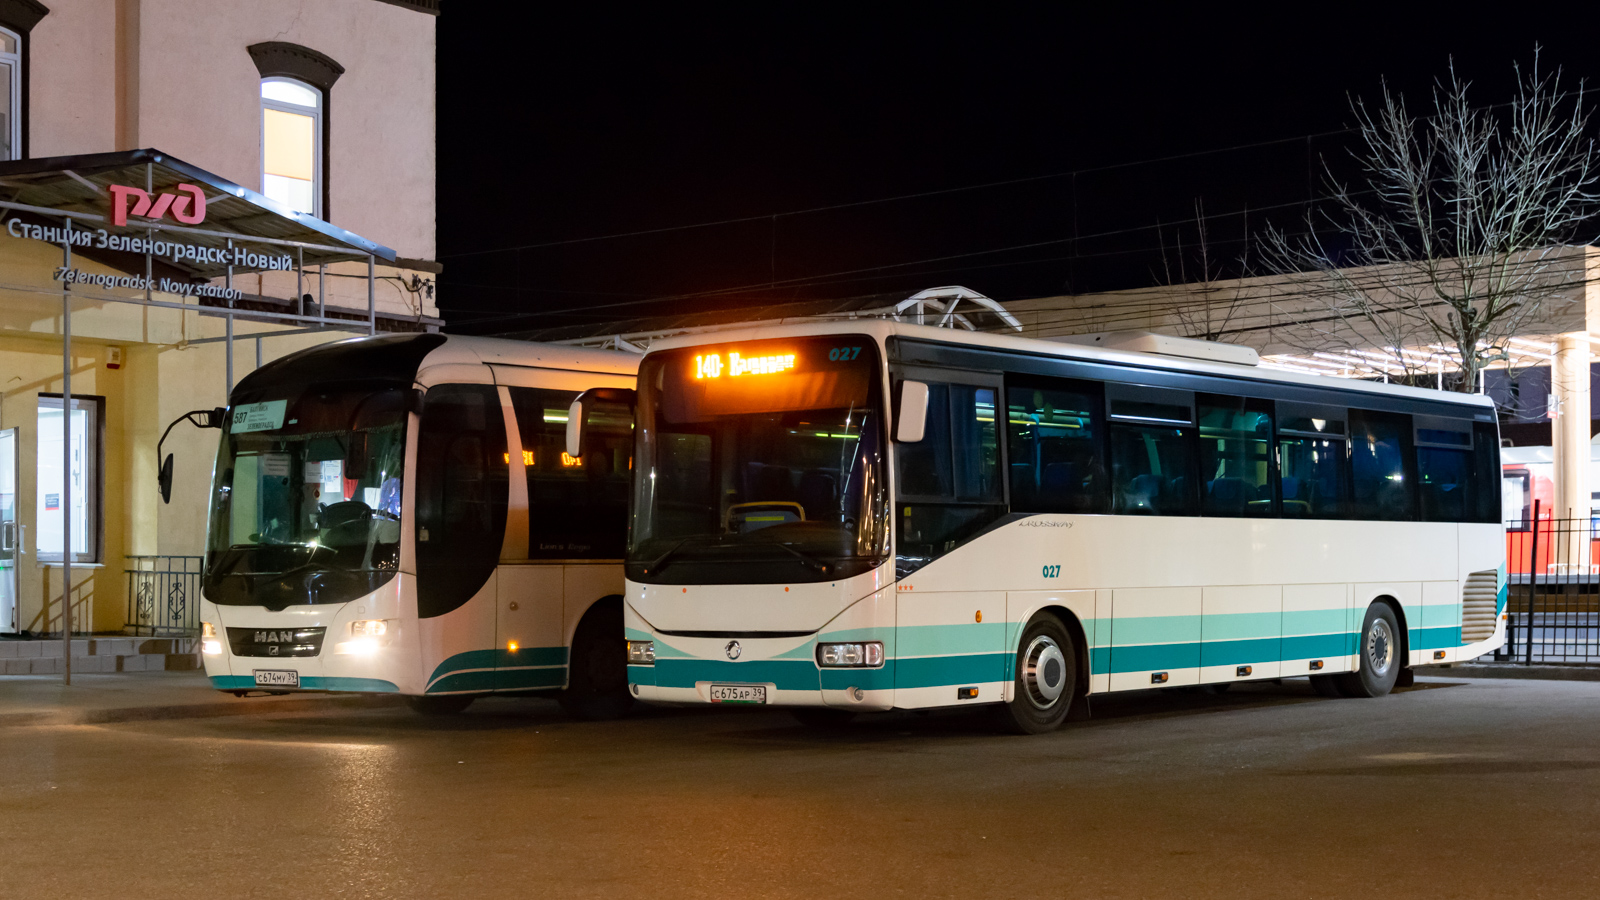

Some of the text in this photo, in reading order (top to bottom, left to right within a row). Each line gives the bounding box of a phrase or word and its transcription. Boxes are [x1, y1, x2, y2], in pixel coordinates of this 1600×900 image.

[7, 217, 293, 272] Станция Зеленоградск-Новый
[57, 266, 243, 300] Zelenogradsk Novy station
[829, 346, 862, 361] 027
[234, 411, 248, 424] 587
[1018, 520, 1074, 529] CROSSWAY
[1042, 565, 1061, 578] 027
[254, 631, 293, 643] MAN
[287, 672, 295, 681] 39
[752, 688, 762, 697] 39
